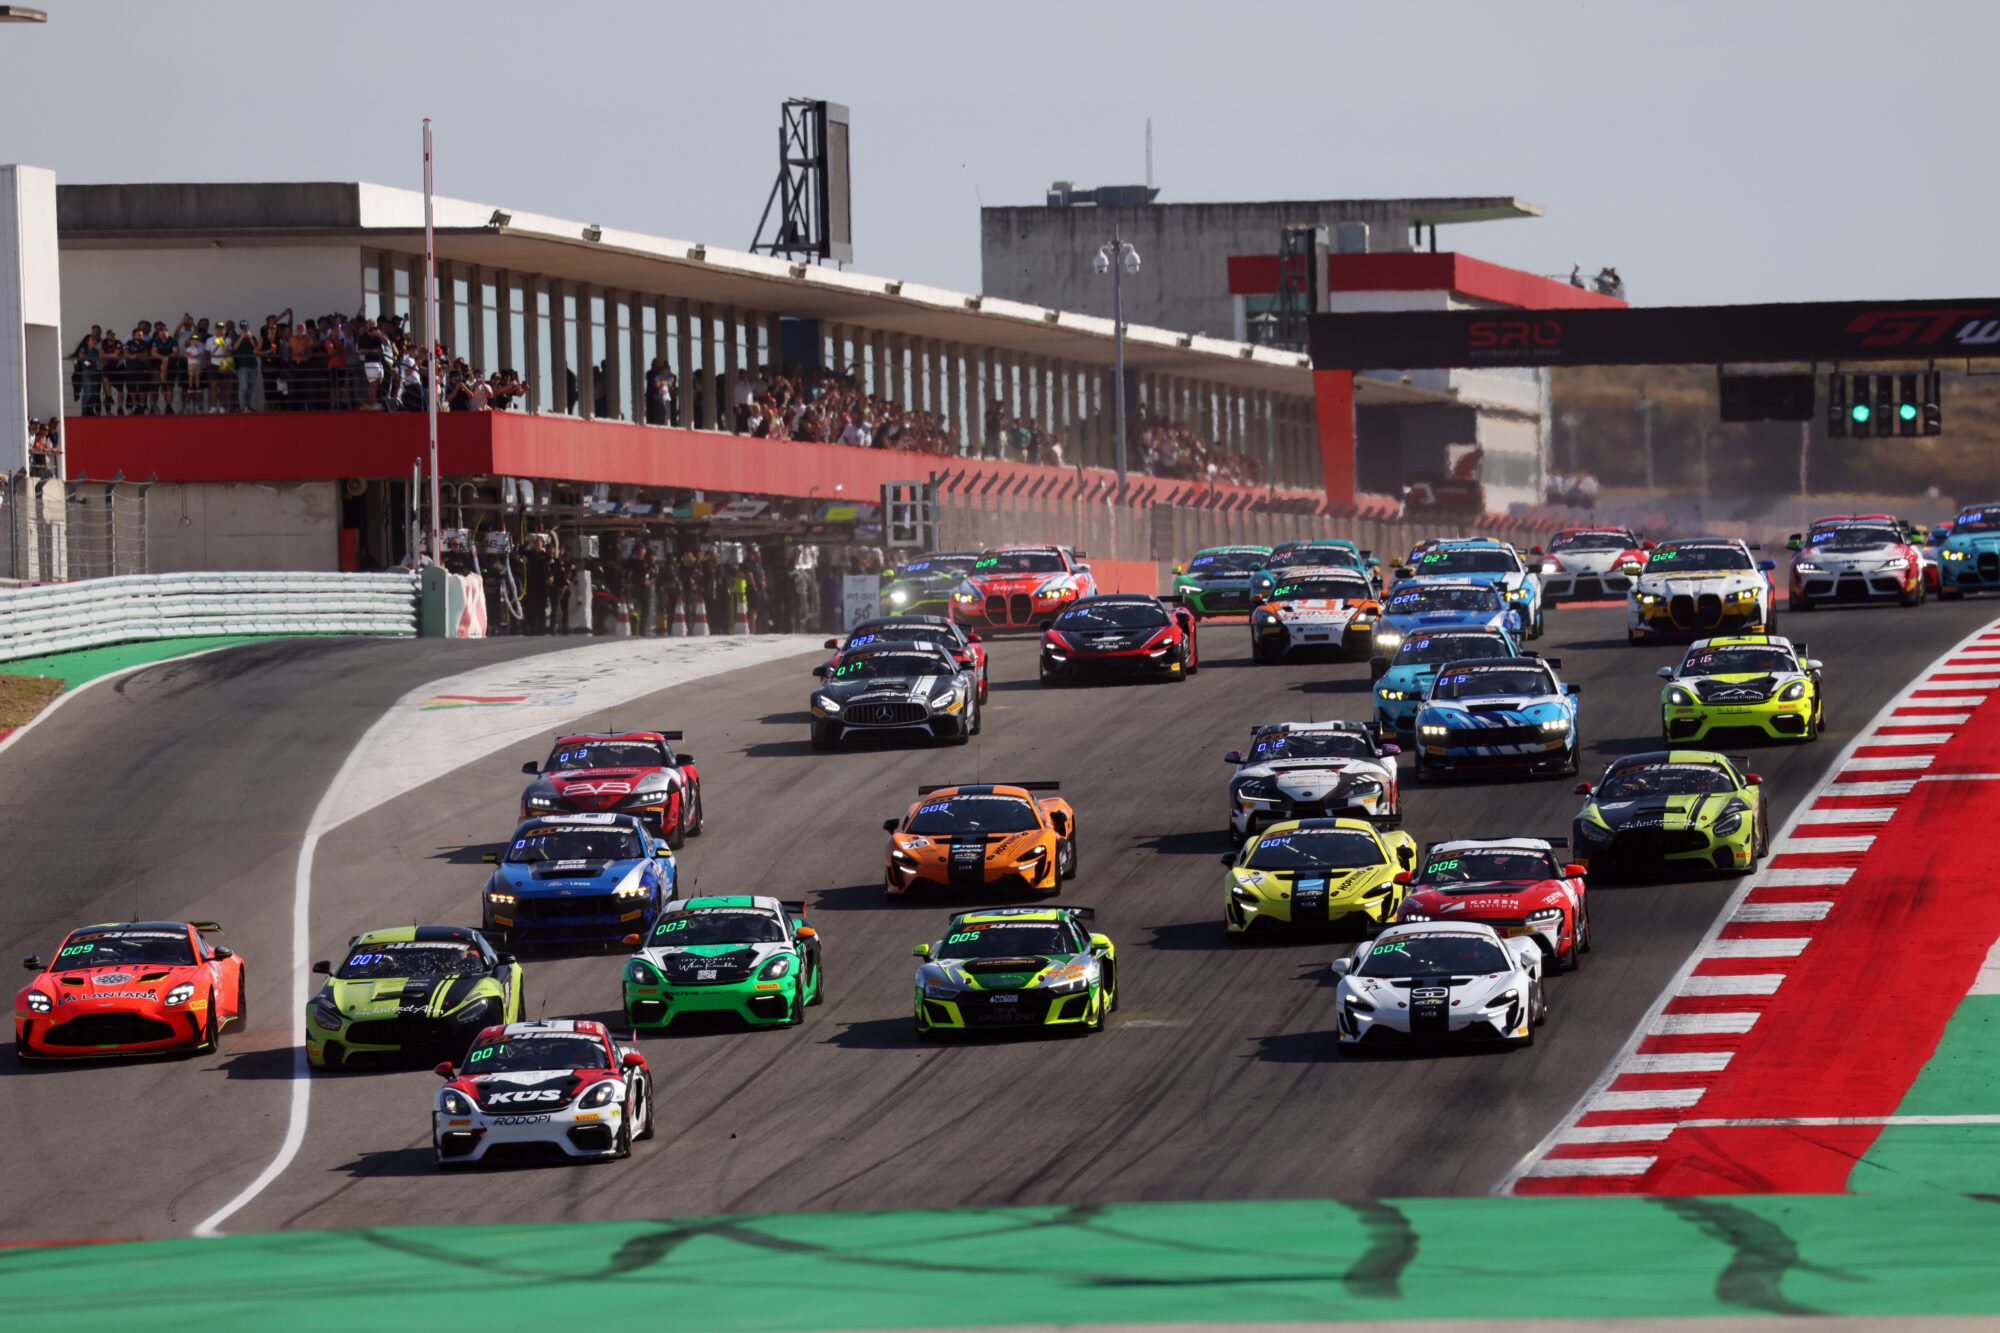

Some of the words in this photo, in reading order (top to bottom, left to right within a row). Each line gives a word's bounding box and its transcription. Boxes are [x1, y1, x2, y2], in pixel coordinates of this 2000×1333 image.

[1468, 320, 1562, 347] SRO
[854, 608, 870, 620] 50
[919, 802, 950, 814] 008
[1260, 837, 1292, 848] 004
[1427, 859, 1458, 874] 006
[655, 919, 688, 936] 003
[948, 931, 981, 944] 005
[61, 944, 94, 957] 009
[1373, 942, 1406, 955] 002
[350, 953, 383, 966] 007
[56, 995, 78, 1007] LA
[81, 991, 159, 1003] LANTANA
[470, 1044, 505, 1063] 001
[494, 1115, 552, 1126] RODOPI
